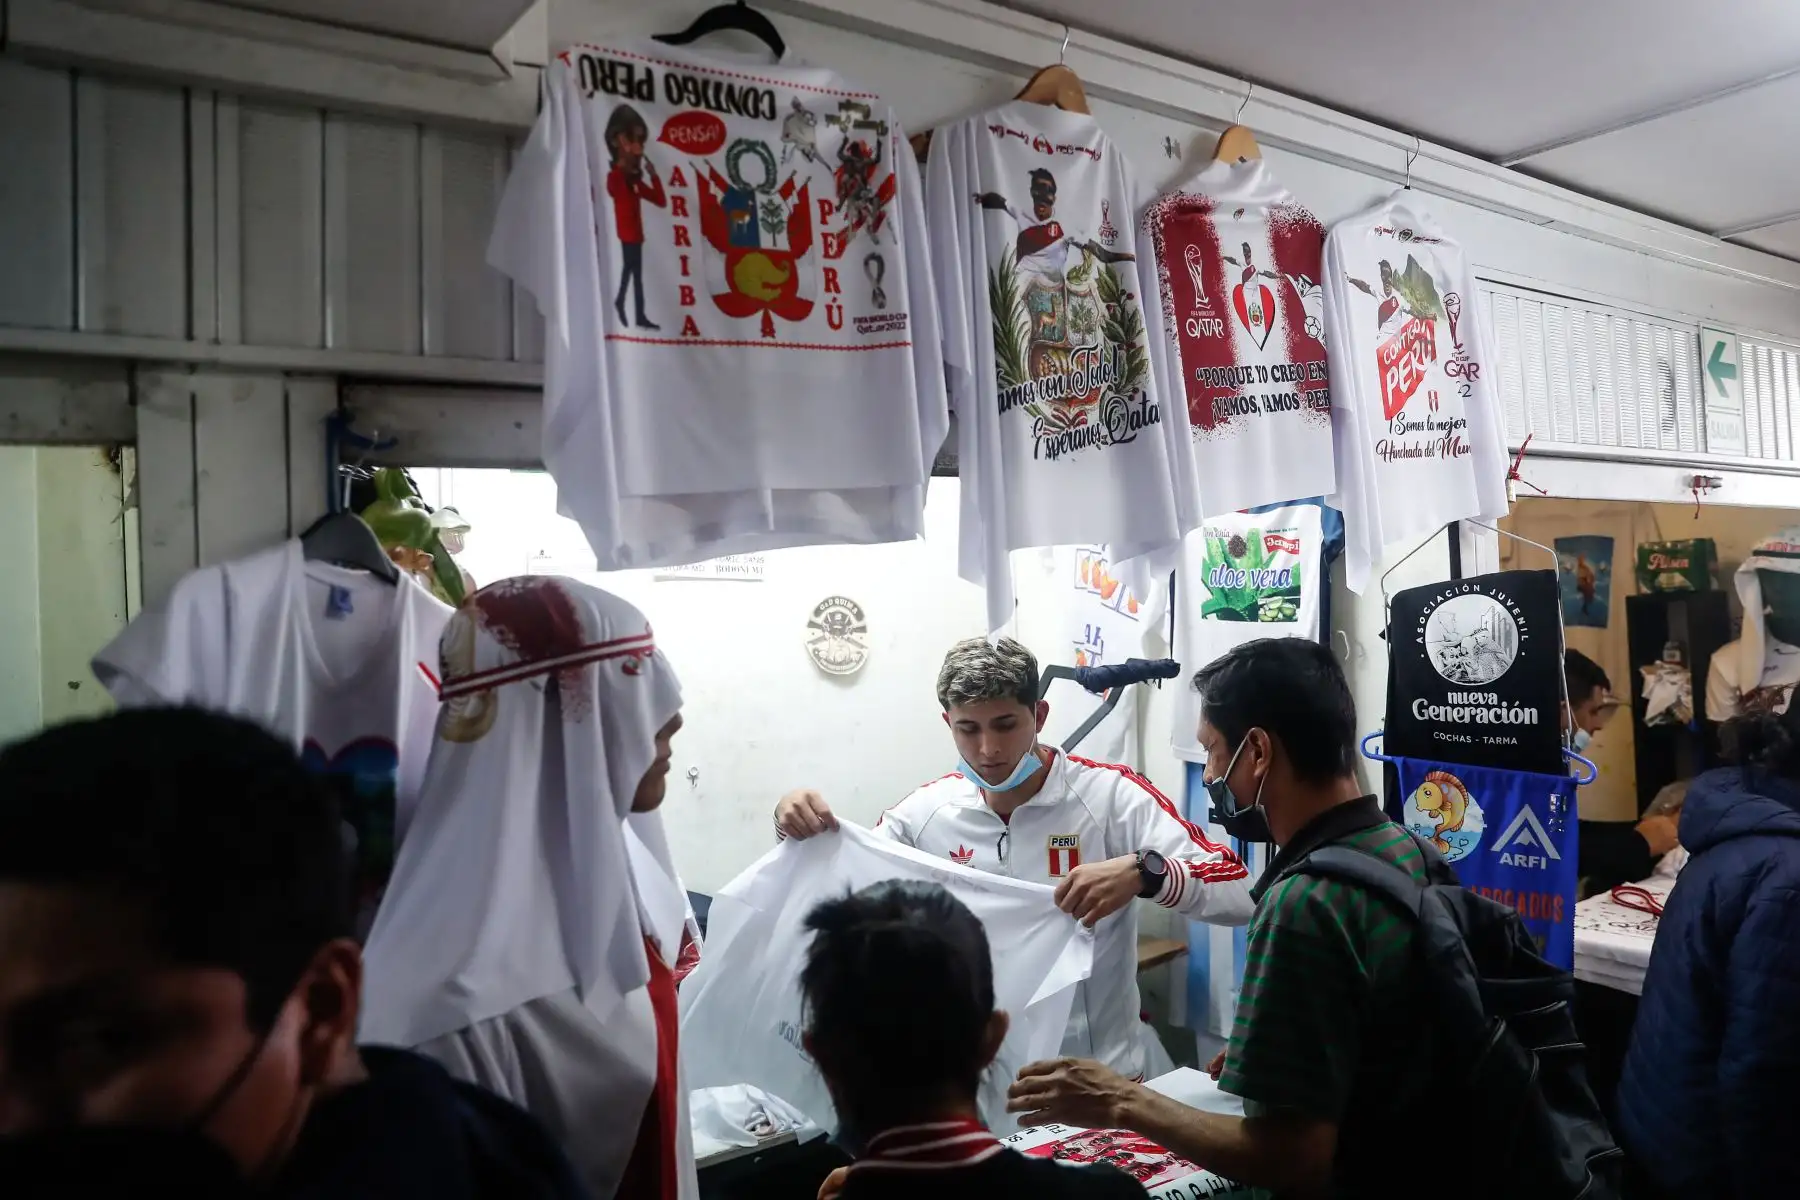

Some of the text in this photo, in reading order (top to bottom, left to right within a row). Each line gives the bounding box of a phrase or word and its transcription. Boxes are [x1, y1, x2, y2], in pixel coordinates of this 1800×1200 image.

[664, 72, 776, 121] CONTIGO
[1185, 318, 1225, 339] QATAR
[1254, 364, 1268, 384] YO
[1270, 362, 1306, 383] CREO
[1306, 360, 1329, 381] EN
[998, 372, 1037, 416] amos
[1039, 373, 1068, 400] con
[1306, 388, 1332, 410] PER
[1104, 391, 1161, 447] Qata
[1436, 416, 1467, 439] mejor
[1435, 435, 1472, 460] Mun
[1209, 563, 1292, 589] aloe vera
[1489, 588, 1529, 642] JUVENIL
[1447, 691, 1498, 706] nueva
[1412, 697, 1539, 725] Generación
[1433, 731, 1472, 743] COCHAS
[1482, 736, 1518, 745] TARMA
[1051, 837, 1076, 848] PERU
[1499, 852, 1547, 870] ARFI
